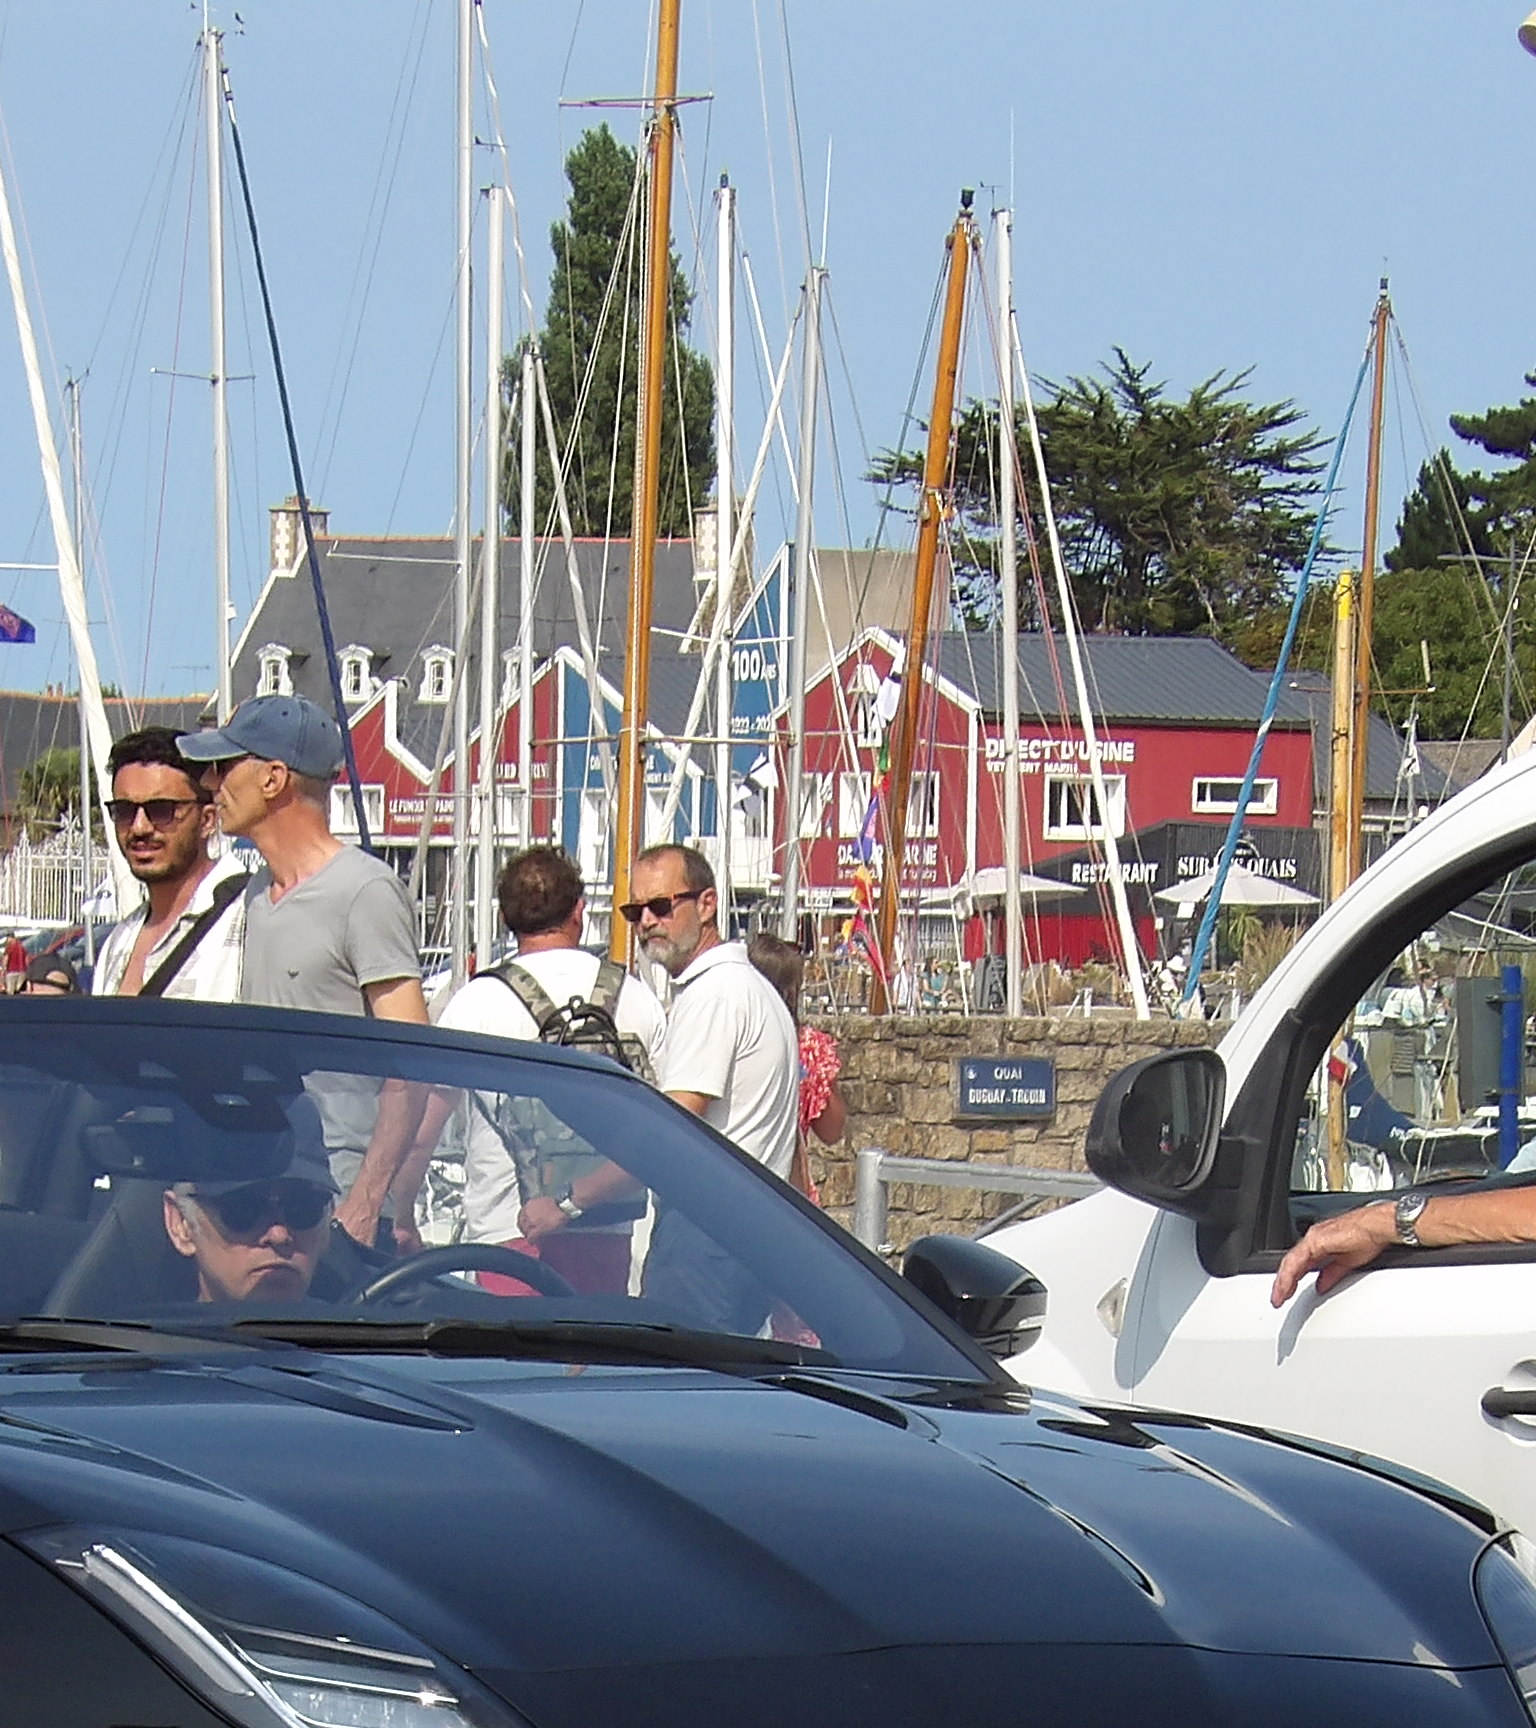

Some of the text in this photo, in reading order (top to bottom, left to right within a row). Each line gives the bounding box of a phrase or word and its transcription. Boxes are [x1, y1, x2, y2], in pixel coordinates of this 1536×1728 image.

[732, 650, 761, 681] 100
[985, 738, 1052, 760] DIECT
[1072, 862, 1159, 883] RESTARANT
[994, 1067, 1023, 1080] QUAI
